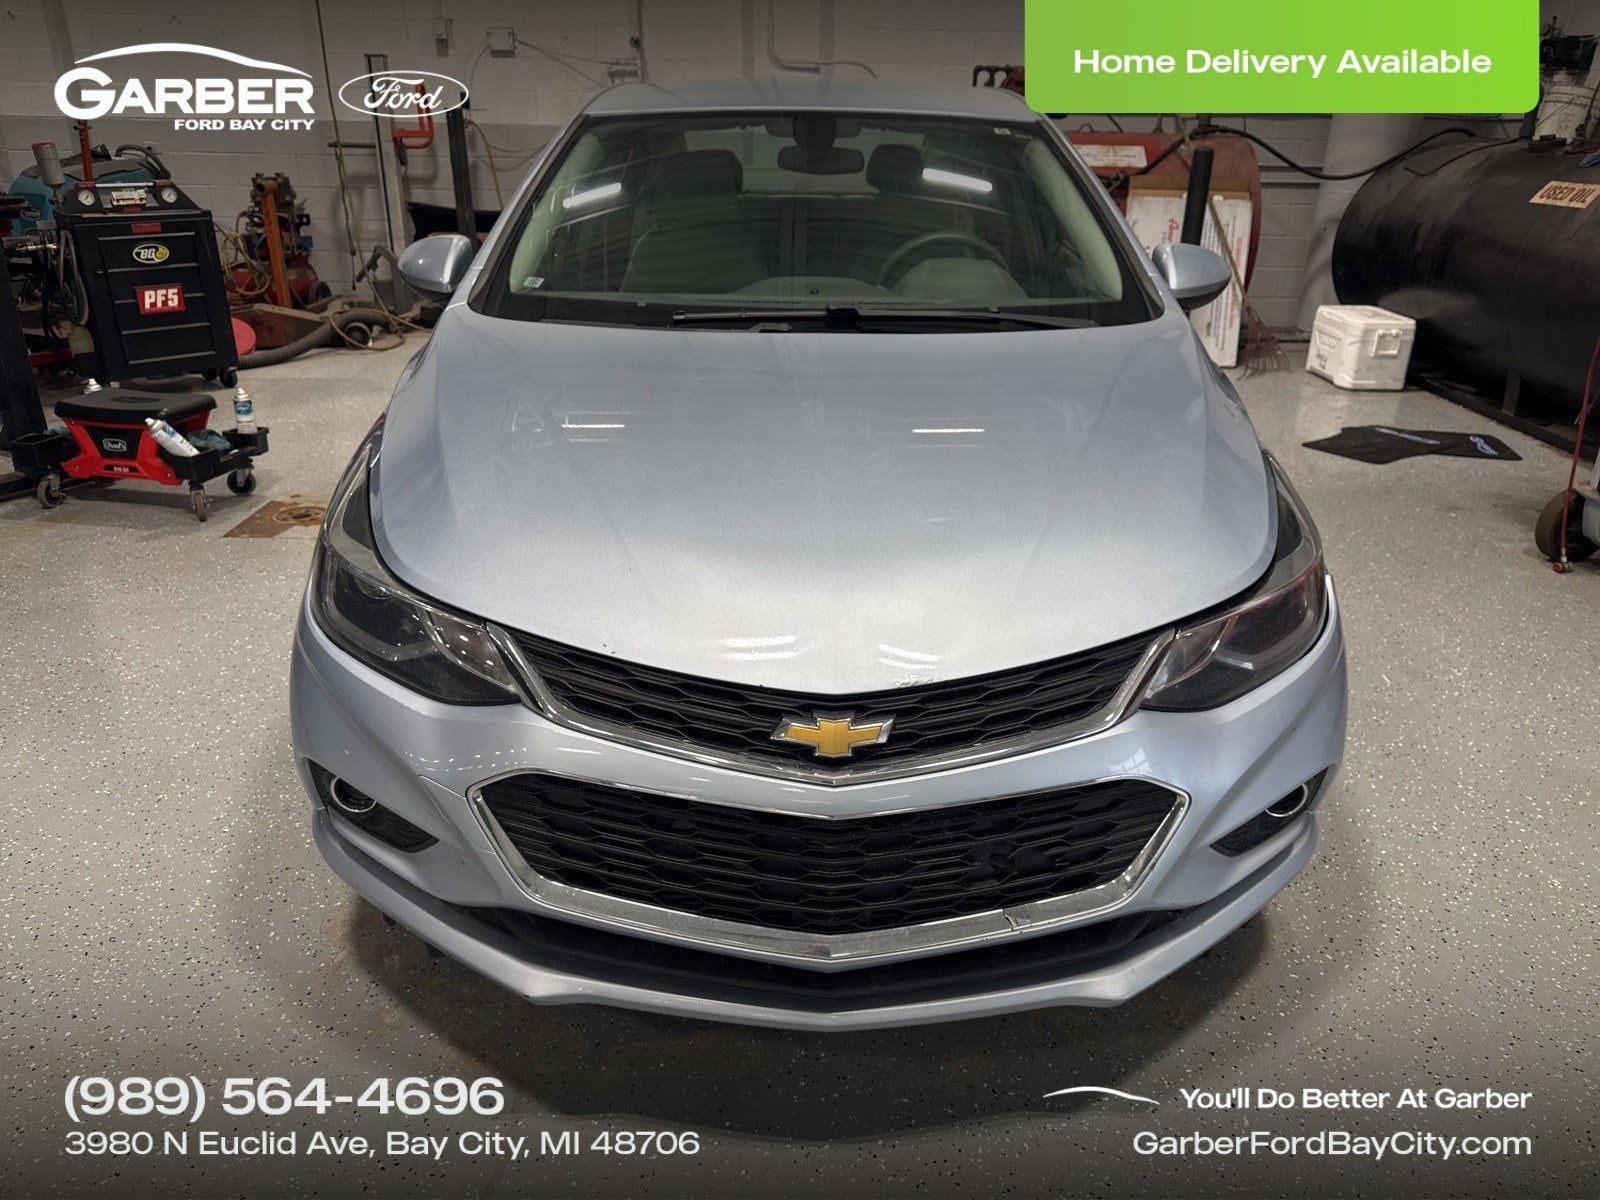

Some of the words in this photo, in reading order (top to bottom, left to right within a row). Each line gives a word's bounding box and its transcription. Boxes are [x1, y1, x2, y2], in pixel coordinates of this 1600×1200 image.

[1540, 185, 1576, 201] USED
[1568, 187, 1596, 203] OIL
[144, 288, 179, 310] PF5
